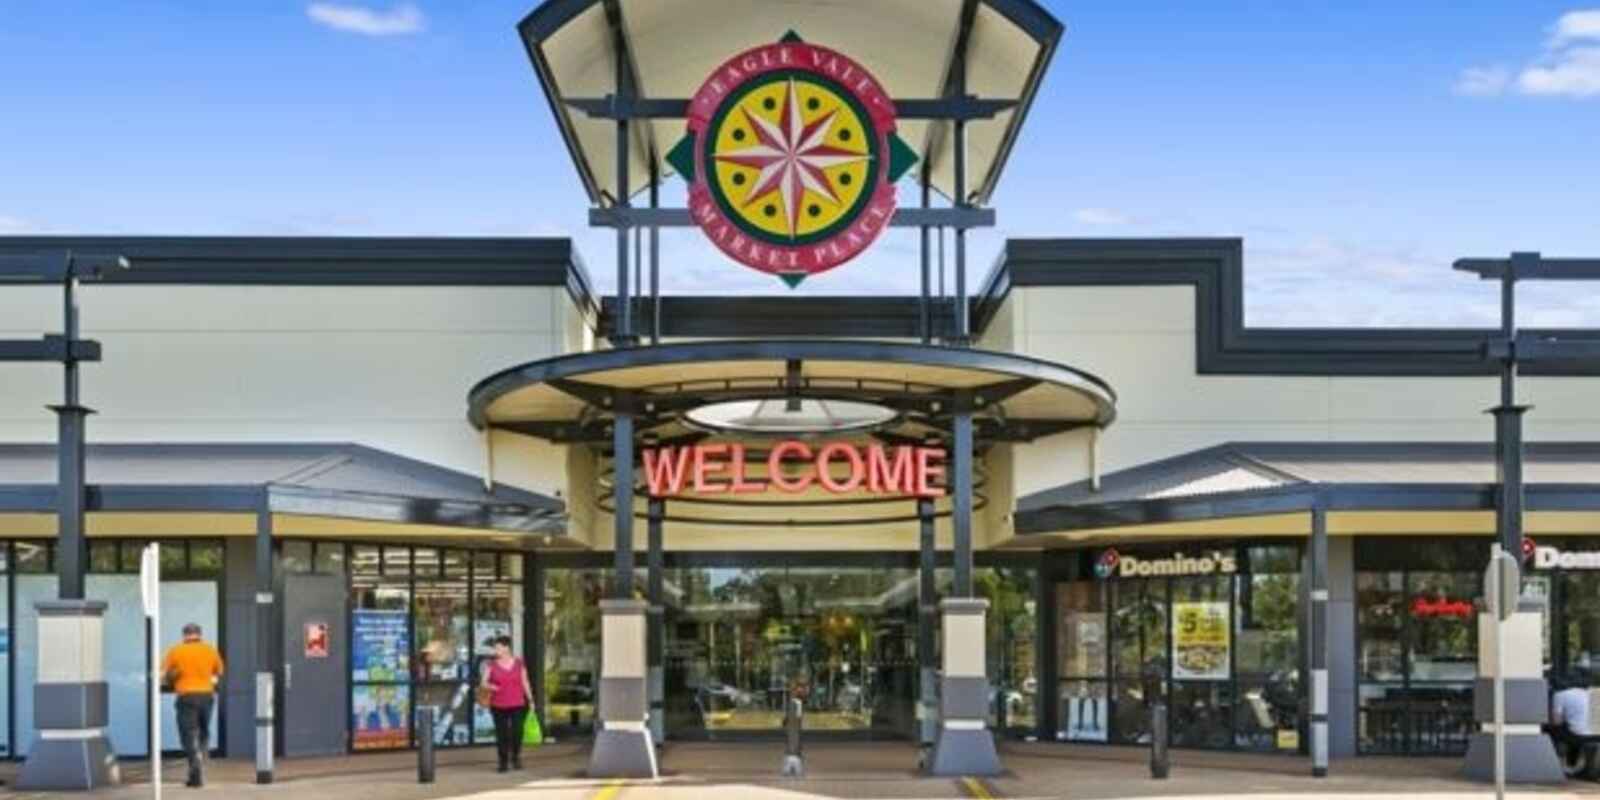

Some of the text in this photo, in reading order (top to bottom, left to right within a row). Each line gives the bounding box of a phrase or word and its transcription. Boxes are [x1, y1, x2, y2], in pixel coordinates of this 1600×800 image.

[710, 47, 872, 94] EAGLE VALE
[698, 203, 886, 267] MARKET PLACE
[642, 439, 946, 498] WELCOME
[1119, 552, 1236, 576] Domino's
